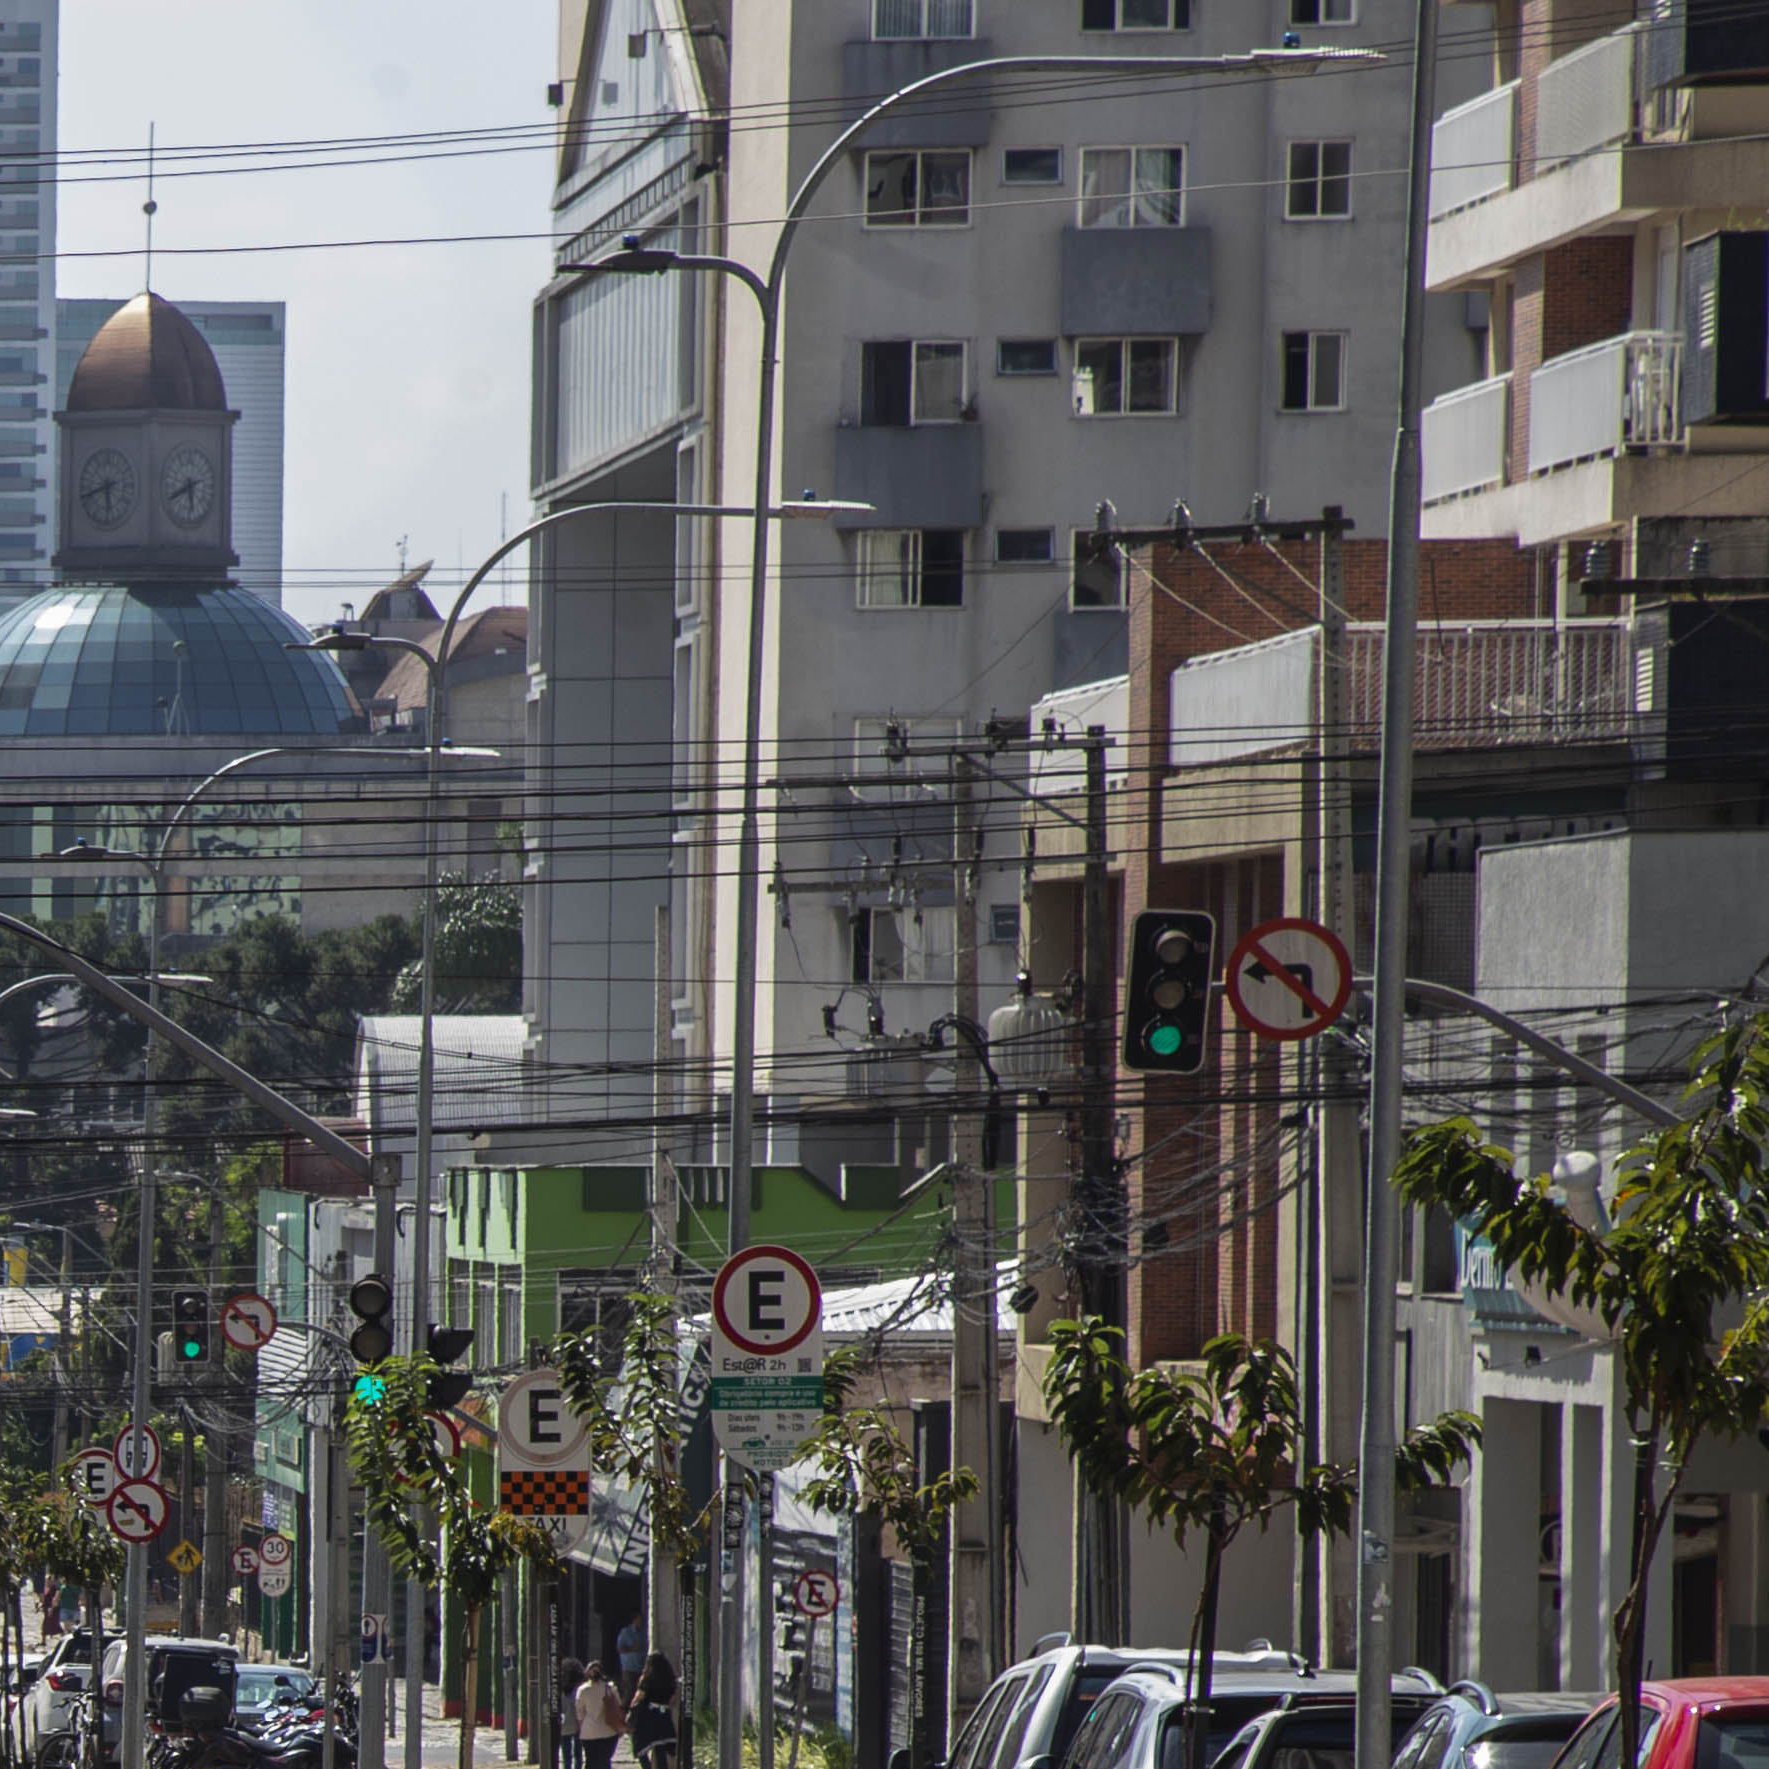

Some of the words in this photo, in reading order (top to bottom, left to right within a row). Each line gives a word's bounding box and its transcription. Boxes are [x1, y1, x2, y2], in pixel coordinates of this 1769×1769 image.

[747, 1271, 785, 1331] E
[722, 1357, 766, 1373] Est@R
[769, 1359, 786, 1371] 2h
[528, 1389, 562, 1443] E
[87, 1462, 106, 1494] E
[525, 1517, 567, 1533] AXI
[267, 1541, 285, 1554] 30
